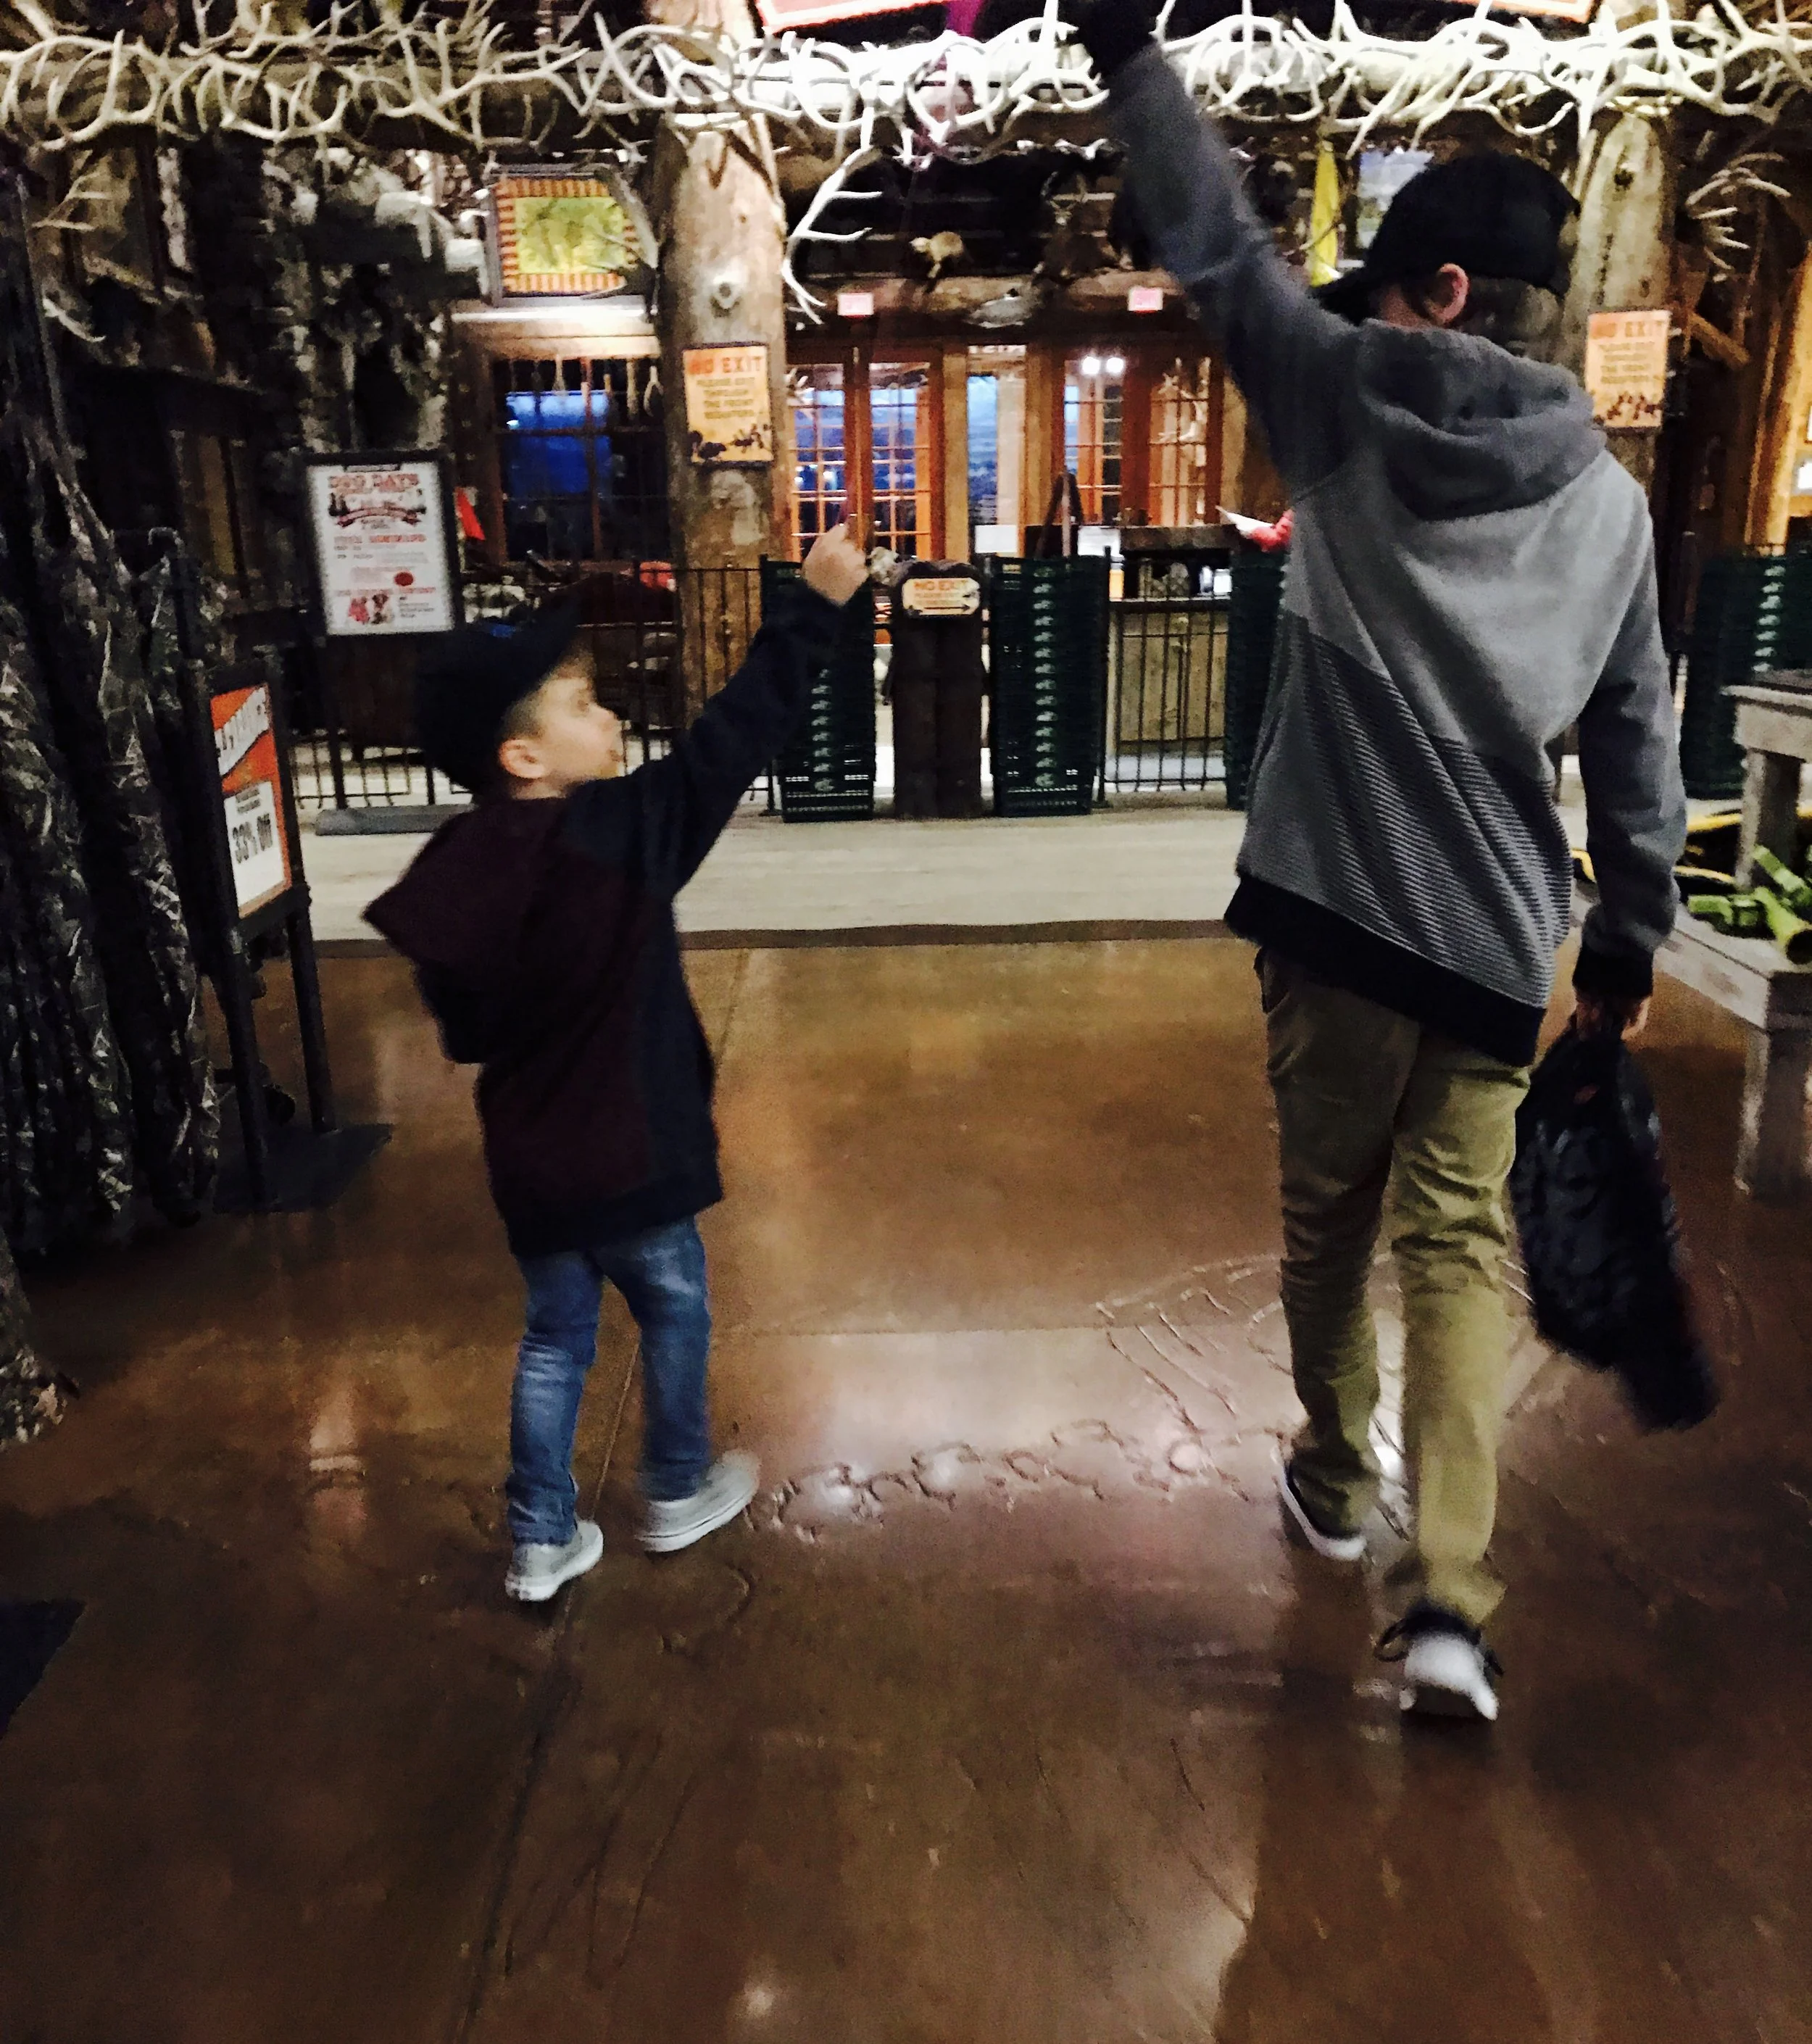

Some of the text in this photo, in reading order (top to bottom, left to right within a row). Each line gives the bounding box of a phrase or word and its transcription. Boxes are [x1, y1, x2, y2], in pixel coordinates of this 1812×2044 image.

[722, 355, 764, 373] EXIT
[914, 580, 968, 591] NO EXIT
